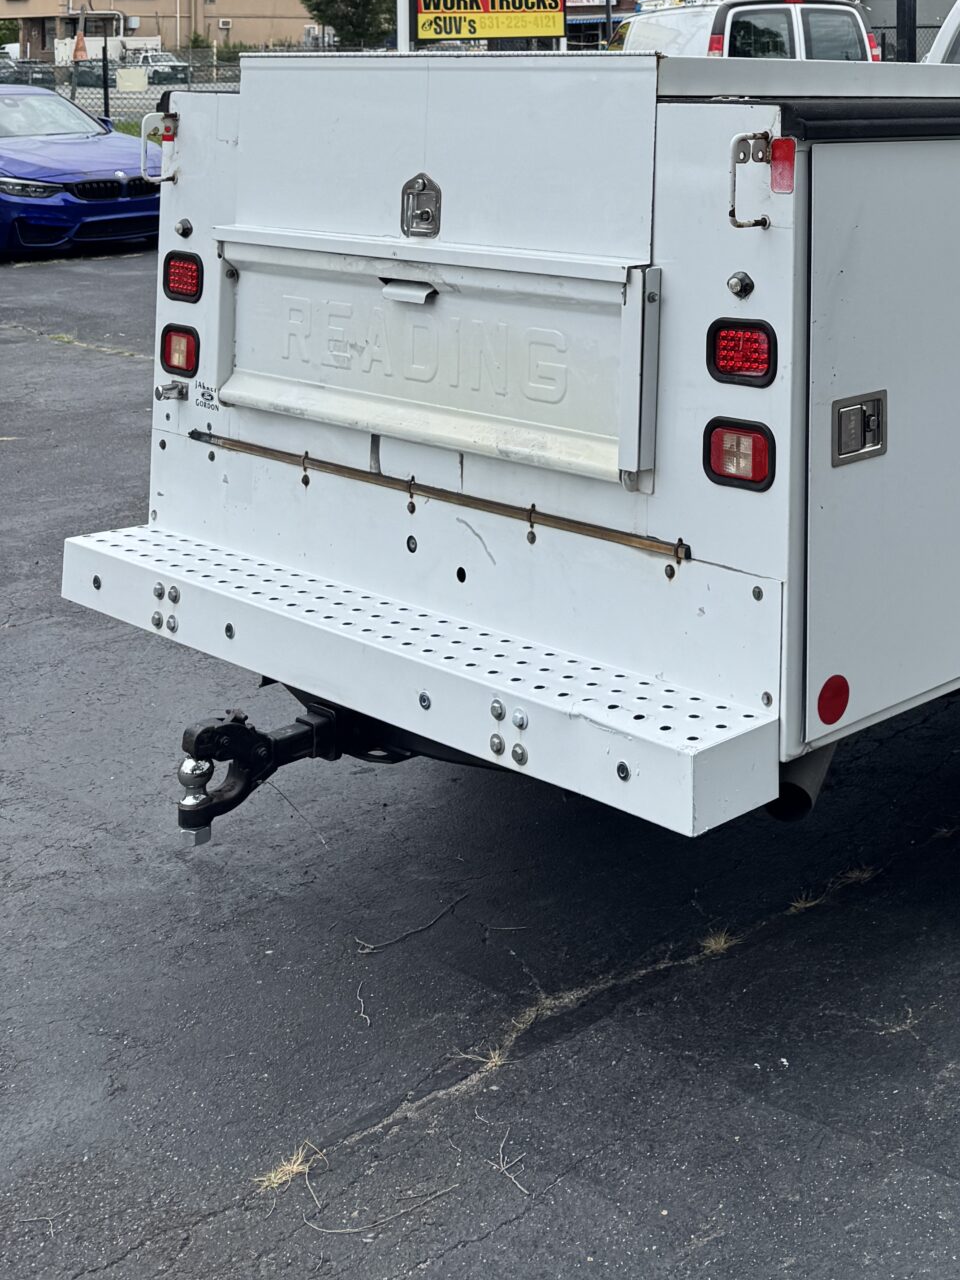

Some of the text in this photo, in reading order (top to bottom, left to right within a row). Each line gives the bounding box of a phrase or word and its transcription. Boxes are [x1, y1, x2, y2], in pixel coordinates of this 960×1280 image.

[433, 16, 477, 35] SUV's
[479, 15, 557, 30] 631-225-4121
[280, 293, 570, 405] READING
[195, 398, 220, 412] GORDON
